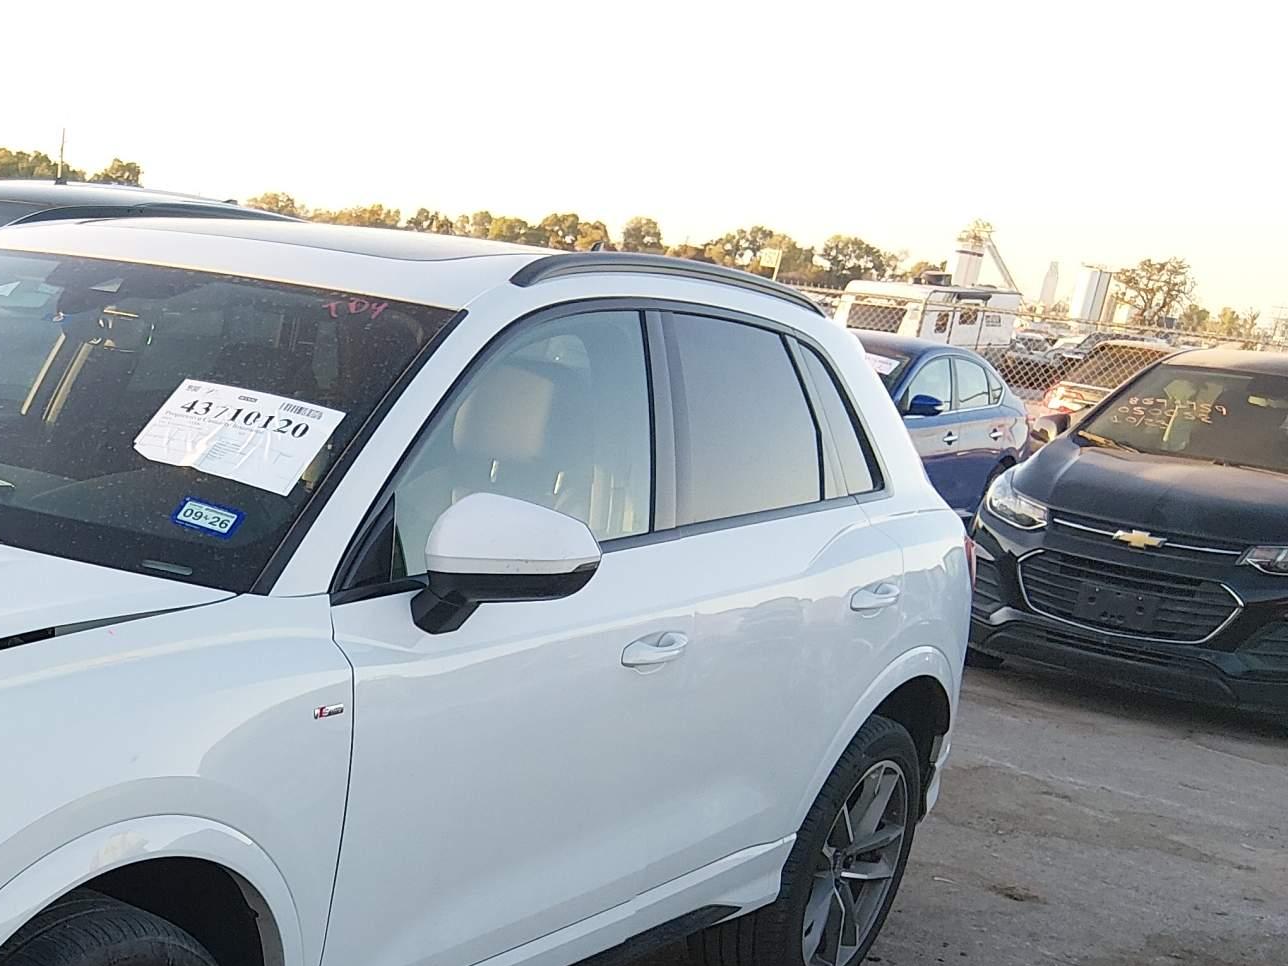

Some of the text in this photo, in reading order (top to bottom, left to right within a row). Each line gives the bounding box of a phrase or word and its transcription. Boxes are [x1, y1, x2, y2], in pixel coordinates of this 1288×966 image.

[180, 399, 310, 439] 43710120
[183, 508, 204, 521] 09
[208, 516, 231, 529] 26
